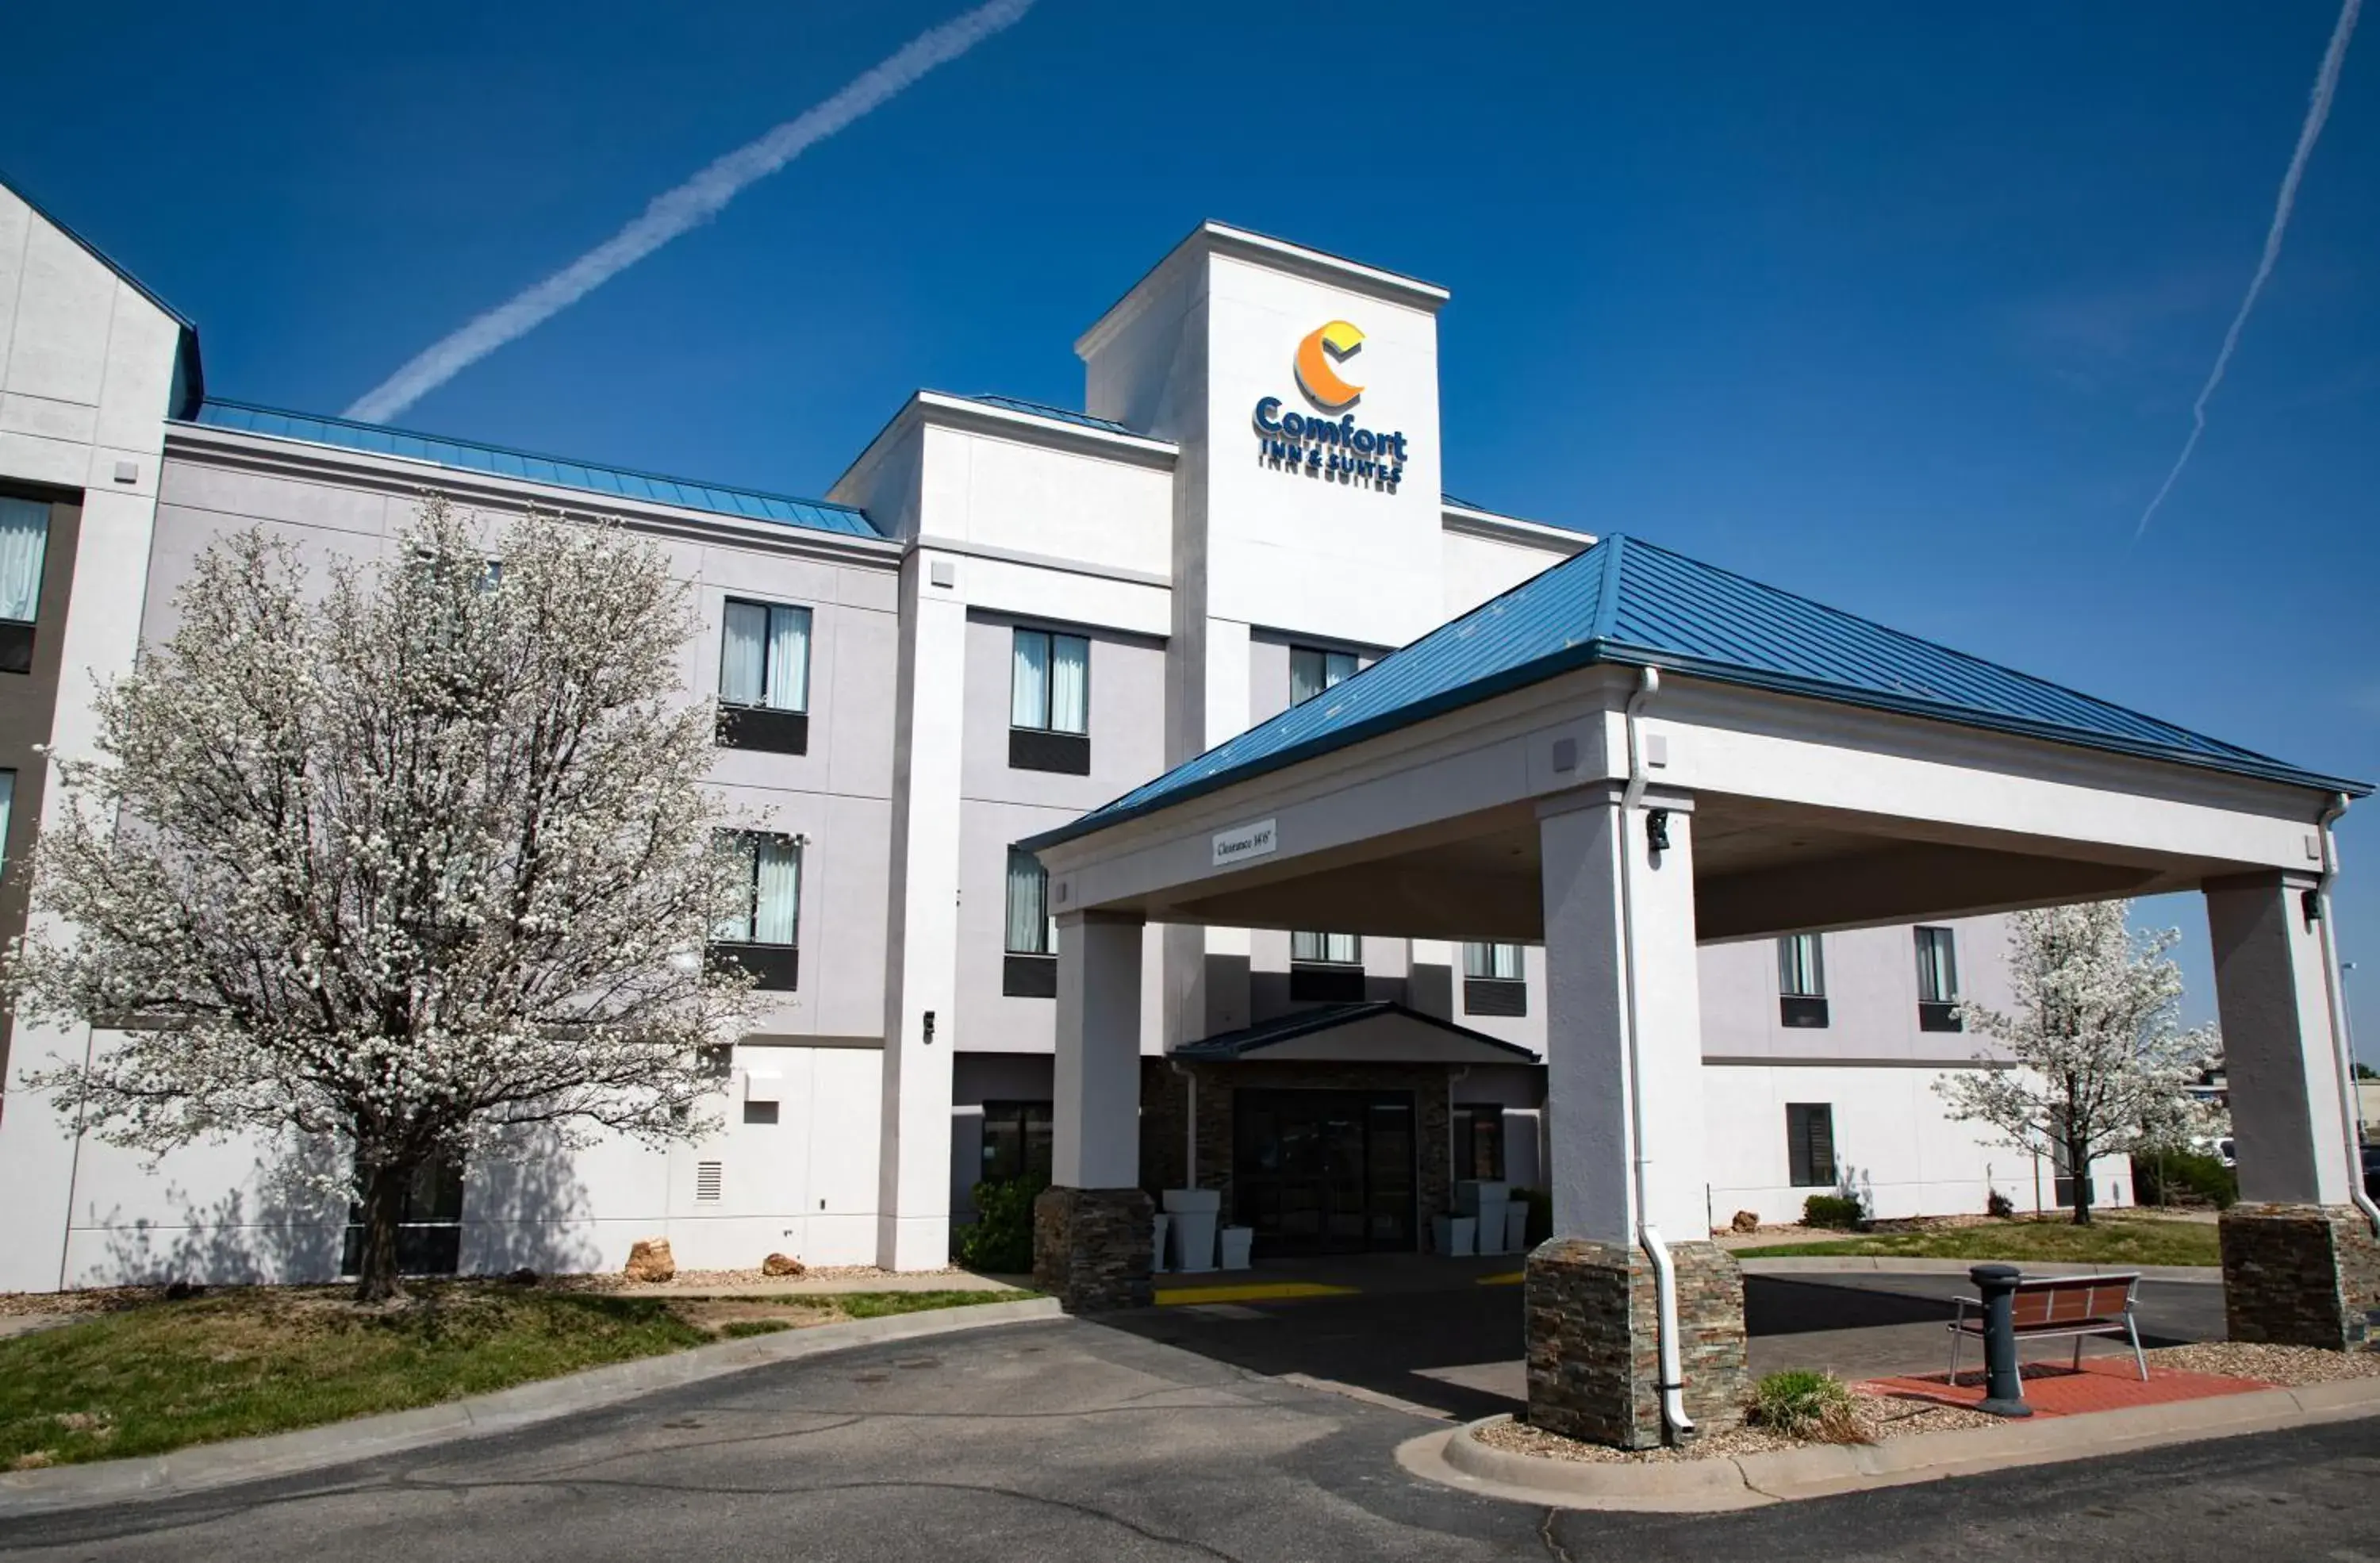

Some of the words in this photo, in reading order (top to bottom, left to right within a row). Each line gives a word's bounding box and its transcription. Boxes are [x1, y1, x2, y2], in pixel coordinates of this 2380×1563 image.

[1256, 396, 1407, 462] Comfort
[1261, 438, 1303, 463] INN
[1308, 448, 1322, 467] &
[1328, 453, 1402, 483] SUITES
